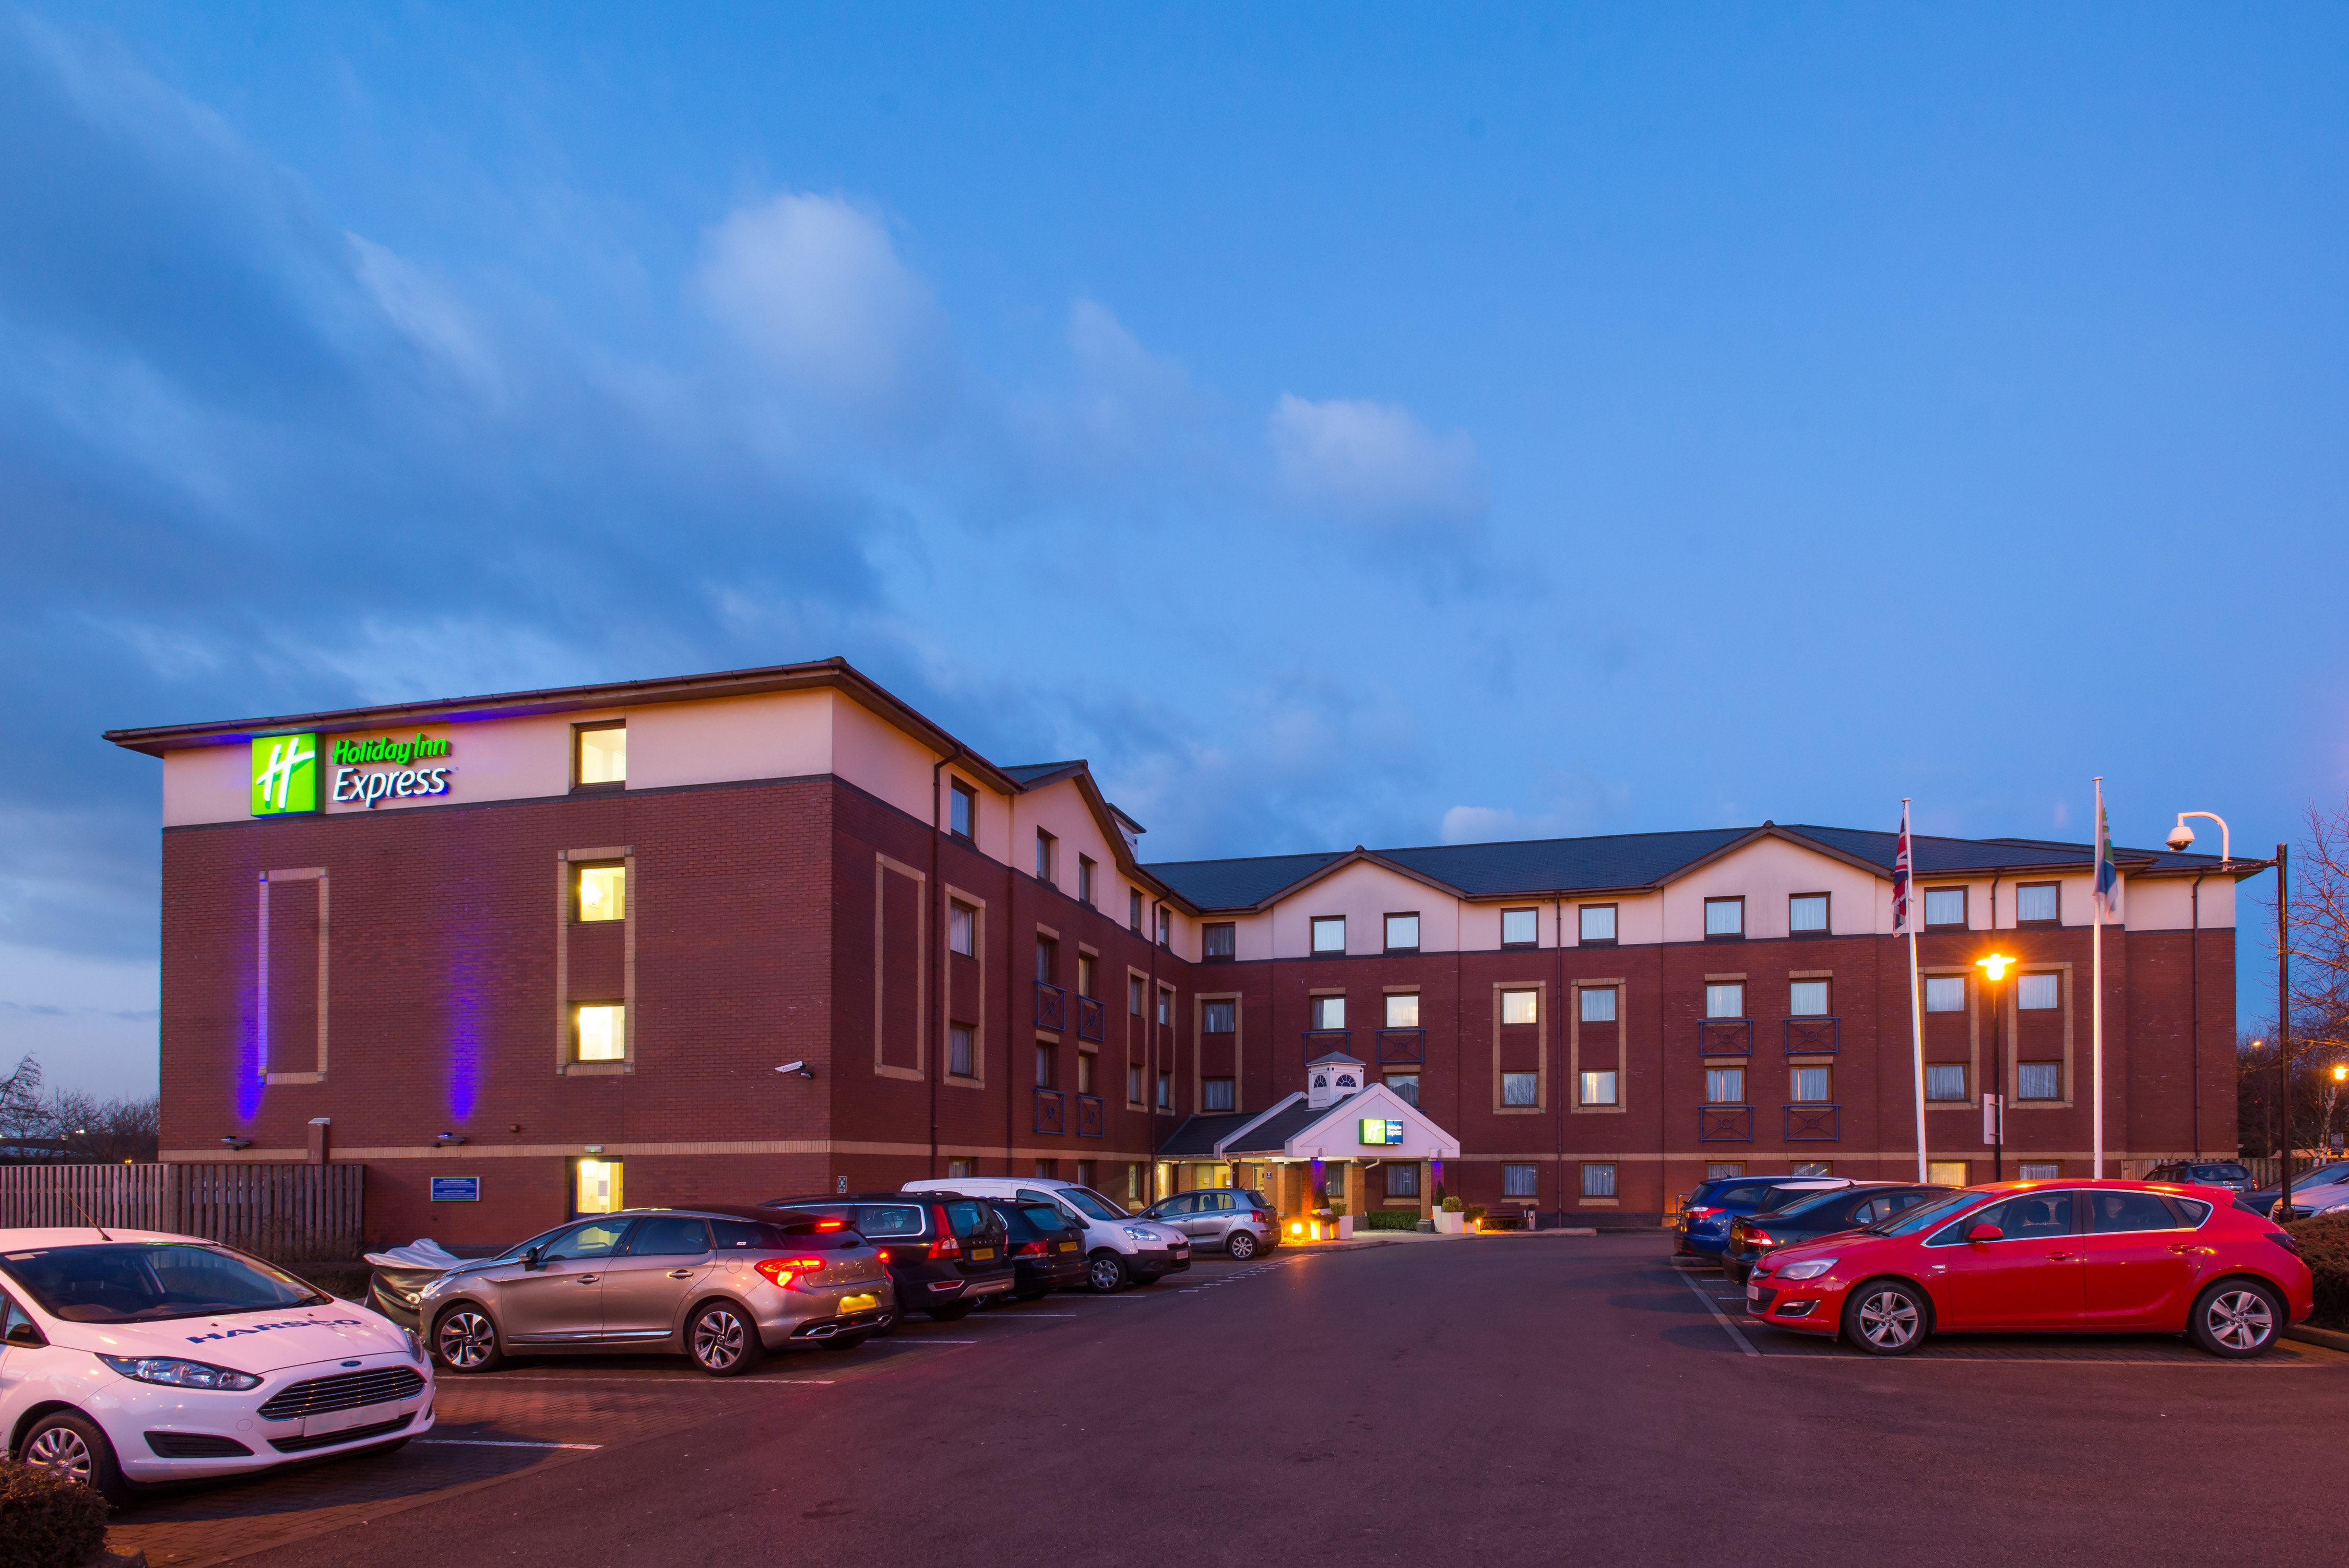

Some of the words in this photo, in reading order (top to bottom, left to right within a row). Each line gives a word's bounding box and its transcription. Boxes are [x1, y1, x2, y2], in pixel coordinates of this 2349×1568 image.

[333, 737, 411, 764] Holiday
[414, 733, 446, 757] Inn
[333, 767, 446, 808] Express
[185, 1320, 362, 1344] HARSCO
